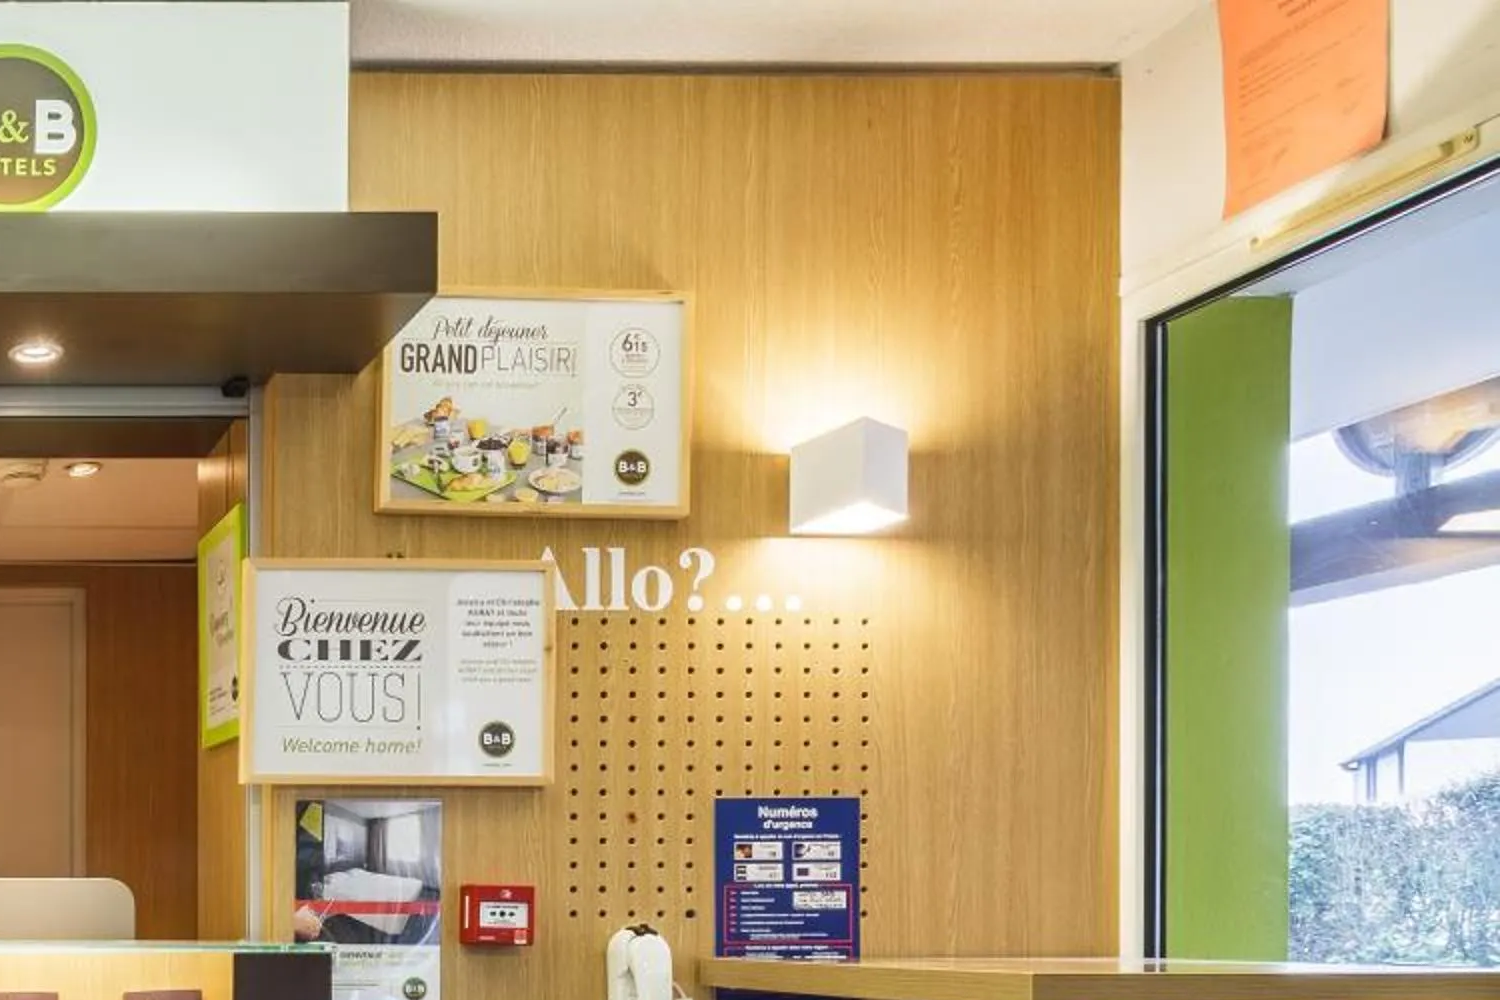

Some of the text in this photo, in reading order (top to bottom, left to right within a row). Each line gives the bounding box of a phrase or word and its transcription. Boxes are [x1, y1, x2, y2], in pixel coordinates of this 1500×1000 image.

[401, 343, 477, 374] GRAND
[274, 597, 426, 637] Bienvenue
[277, 639, 422, 661] CHEZ
[282, 736, 422, 754] Welcome home!
[483, 732, 510, 745] B&B
[757, 804, 819, 818] Numéros
